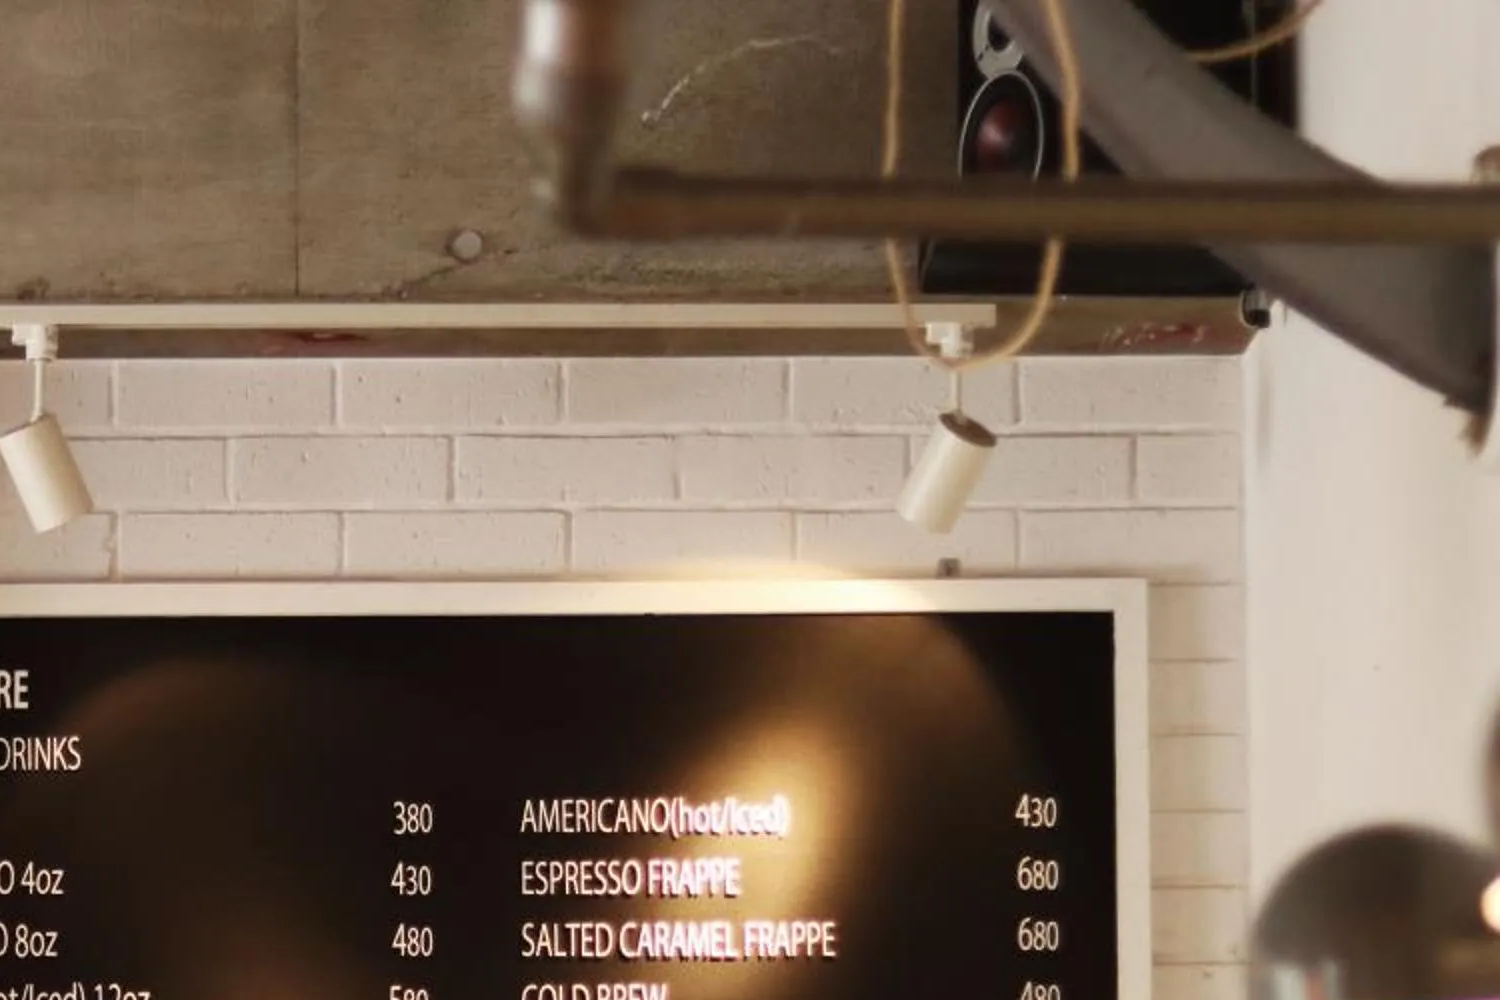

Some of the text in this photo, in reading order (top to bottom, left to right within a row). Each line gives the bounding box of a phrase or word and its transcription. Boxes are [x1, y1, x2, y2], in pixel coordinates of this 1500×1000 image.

[393, 802, 433, 835] 380
[1015, 795, 1057, 829] 430
[21, 863, 63, 896] 4oz
[390, 863, 432, 896] 430
[520, 859, 741, 897] ESPRESSO FRAPPE
[1018, 859, 1059, 892] 680
[15, 924, 58, 958] 8oz
[392, 923, 433, 958] 480
[520, 921, 836, 959] SALTED CARAMEL FRAPPE
[1018, 919, 1060, 952] 680
